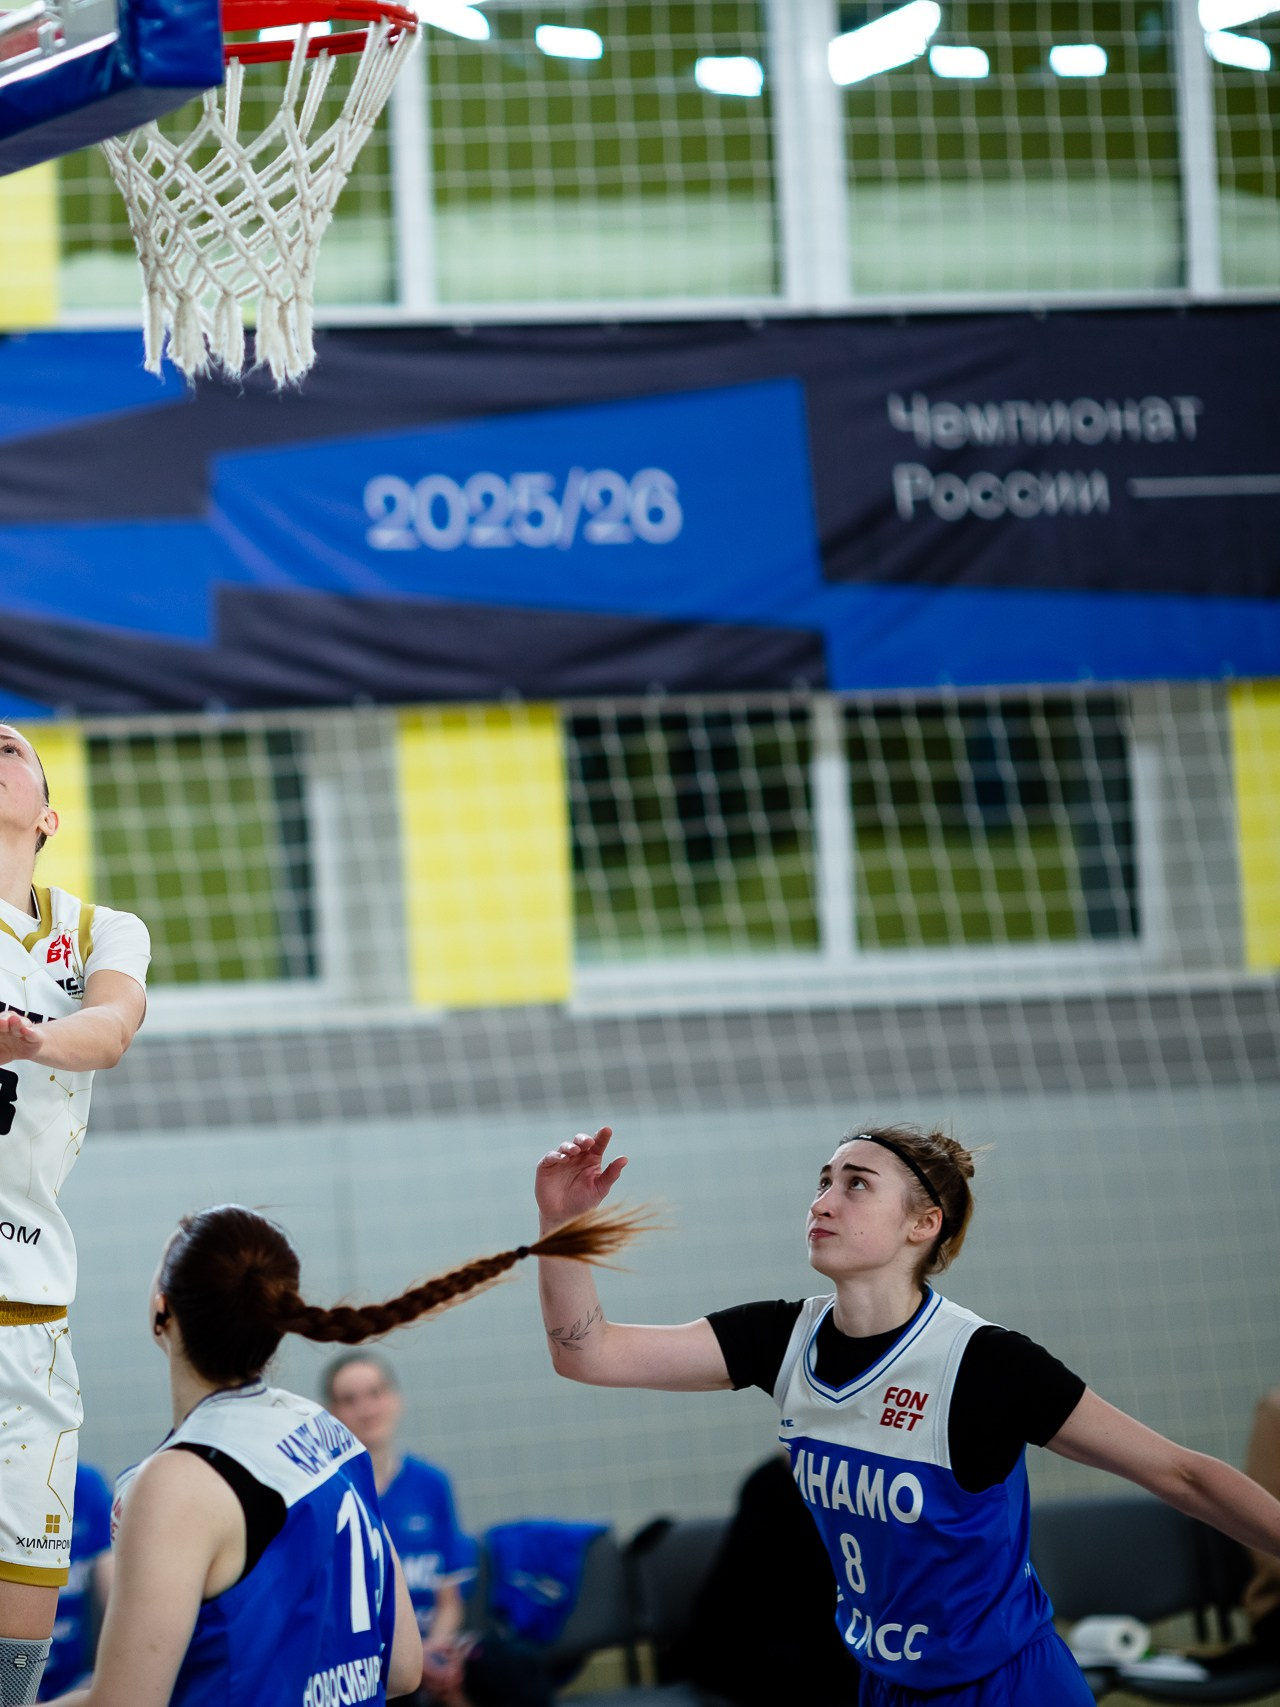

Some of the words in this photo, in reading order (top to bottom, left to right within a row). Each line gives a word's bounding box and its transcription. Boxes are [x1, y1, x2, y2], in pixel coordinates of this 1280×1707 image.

[887, 390, 1204, 448] Чемпионат
[363, 466, 683, 551] 2025/26
[892, 462, 1111, 521] России
[880, 1407, 925, 1431] BET
[883, 1386, 930, 1411] FON
[839, 1532, 867, 1594] 8
[302, 1655, 383, 1707] НОВОСИБИР
